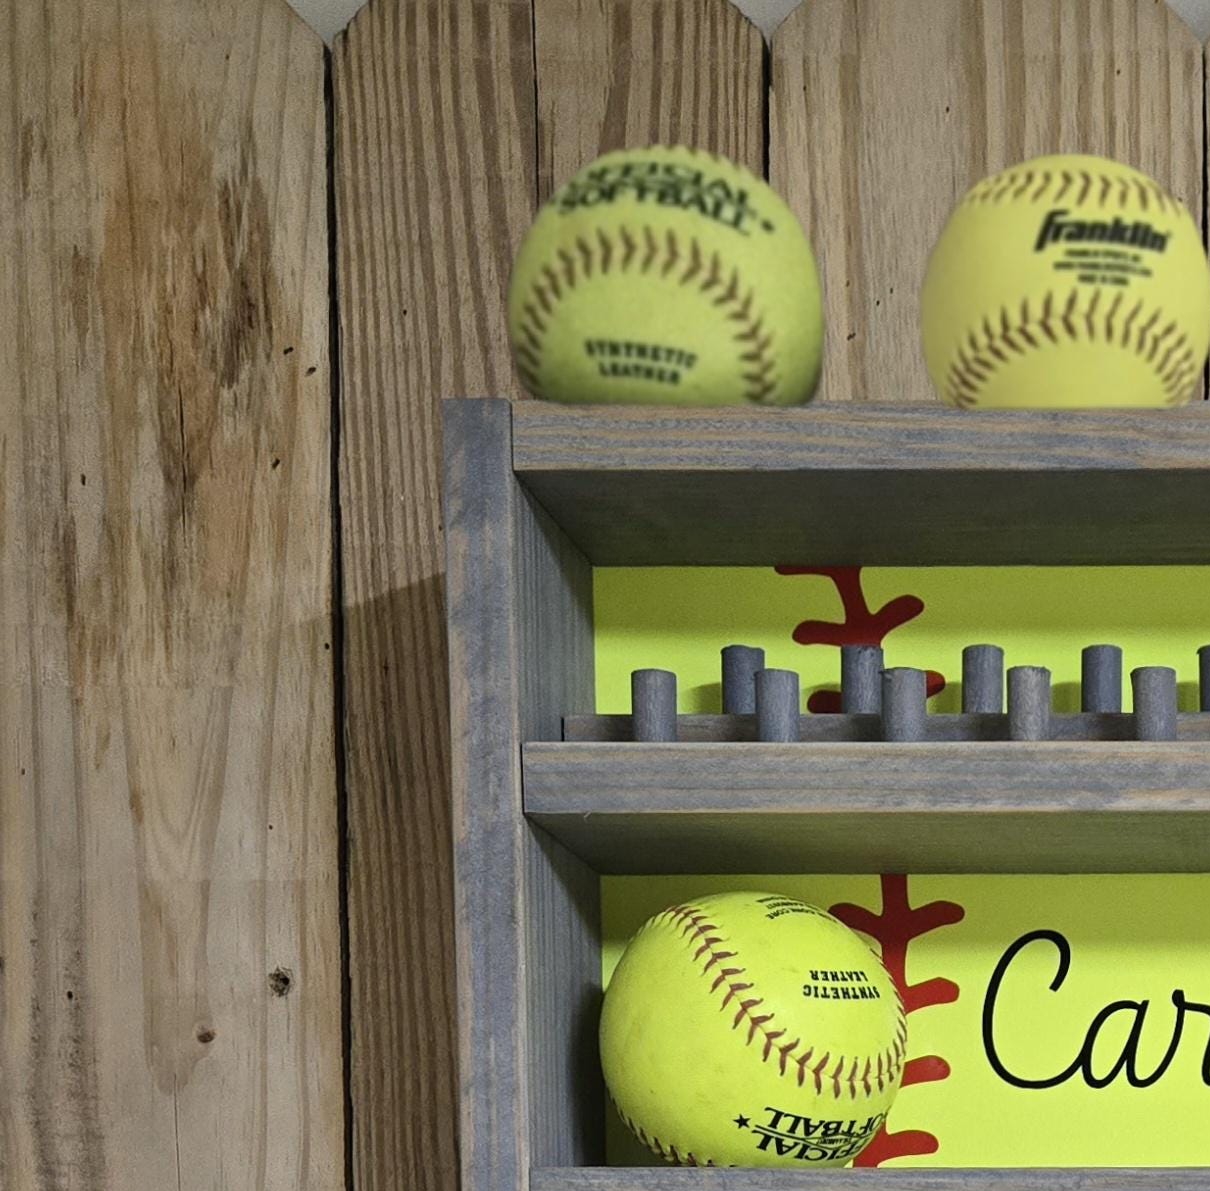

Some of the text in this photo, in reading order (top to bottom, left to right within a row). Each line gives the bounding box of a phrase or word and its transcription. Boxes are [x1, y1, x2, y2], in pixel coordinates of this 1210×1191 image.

[584, 339, 698, 369] SYNTHETIC
[598, 362, 680, 386] LEATHER
[809, 970, 868, 982] LEATHER
[802, 984, 880, 1000] SYNTHETIC
